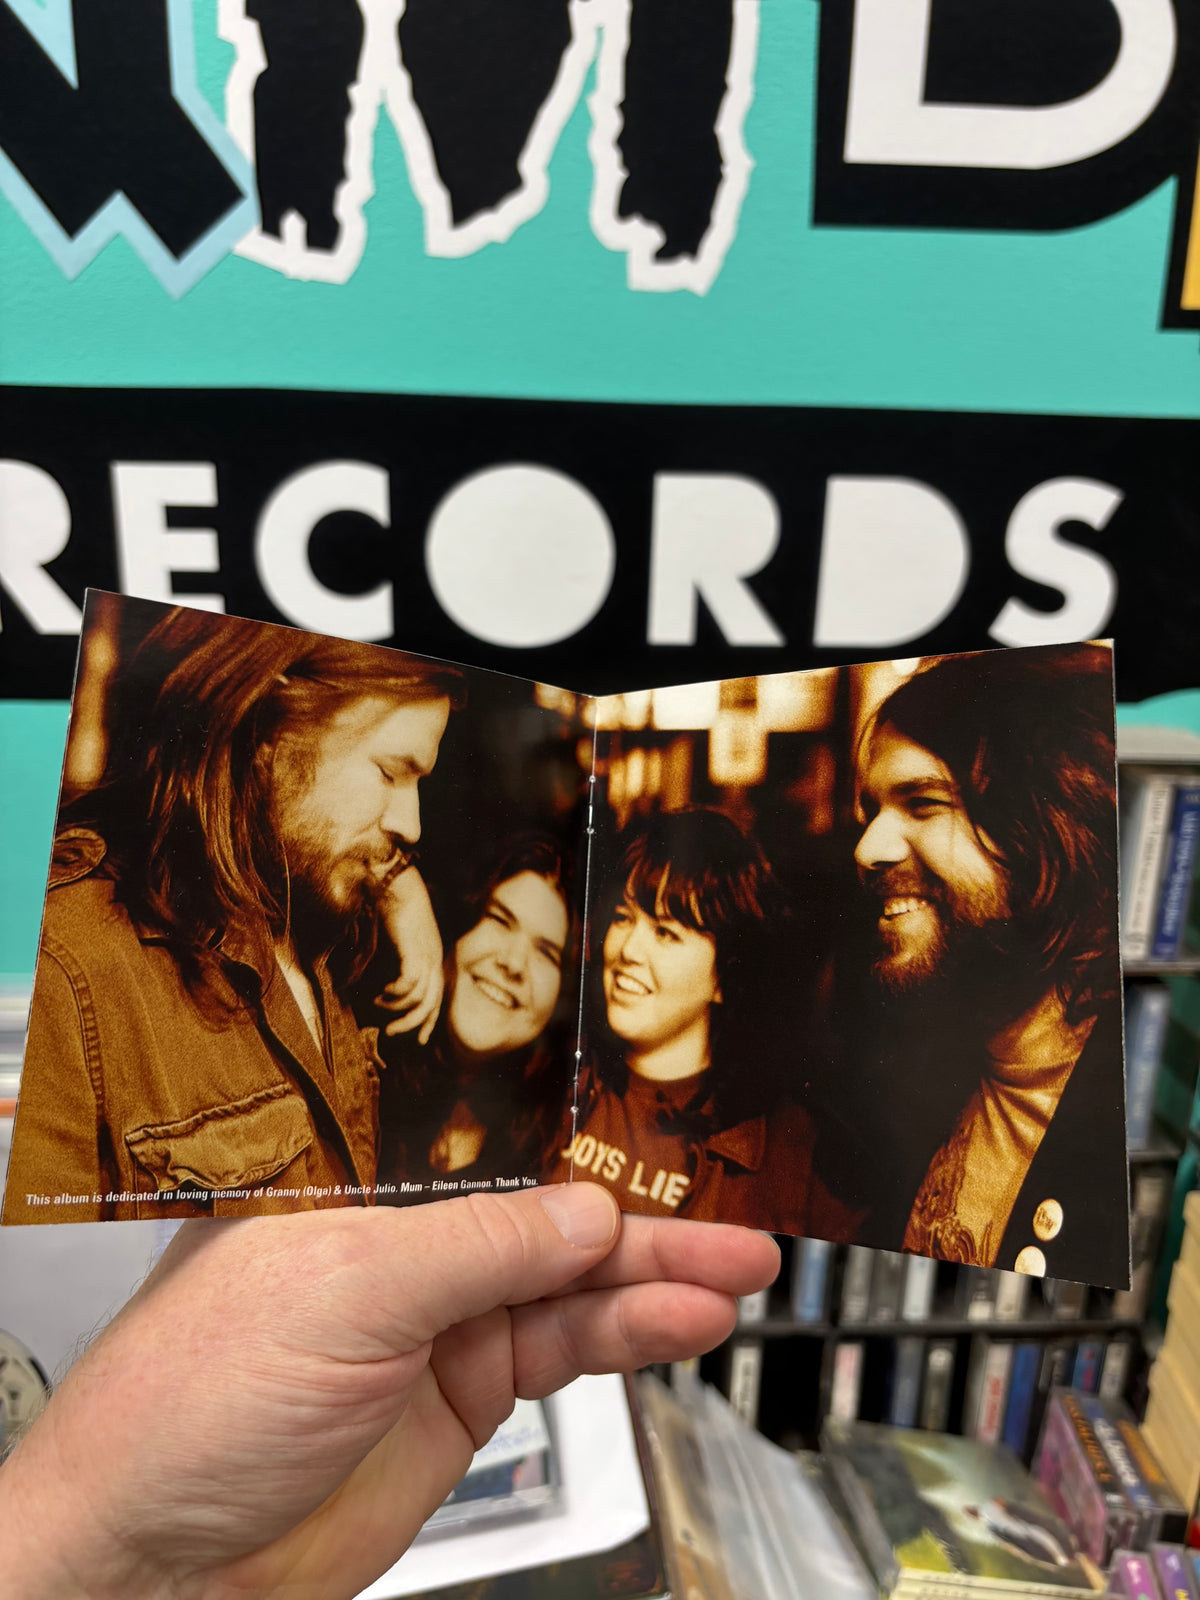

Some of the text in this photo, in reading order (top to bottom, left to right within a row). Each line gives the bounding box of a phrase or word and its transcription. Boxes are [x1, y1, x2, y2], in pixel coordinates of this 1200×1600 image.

[0, 458, 1125, 649] RECORDS
[26, 1193, 50, 1206] This
[54, 1191, 89, 1204] album
[92, 1191, 102, 1203] is
[105, 1190, 159, 1203] dedicated
[163, 1190, 173, 1201] in
[176, 1188, 208, 1201] loving
[211, 1187, 251, 1200] memory
[254, 1187, 263, 1197] of
[266, 1185, 301, 1199] Granny
[302, 1185, 332, 1197] (Olga)
[334, 1185, 342, 1195] &
[344, 1183, 371, 1195] Uncle
[373, 1182, 398, 1194] Julio.
[400, 1181, 423, 1193] Mum
[432, 1178, 459, 1191] Eileen
[460, 1178, 493, 1190] Gannon.
[495, 1176, 521, 1188] Thank
[522, 1175, 539, 1187] You.
[629, 1161, 690, 1208] LIE
